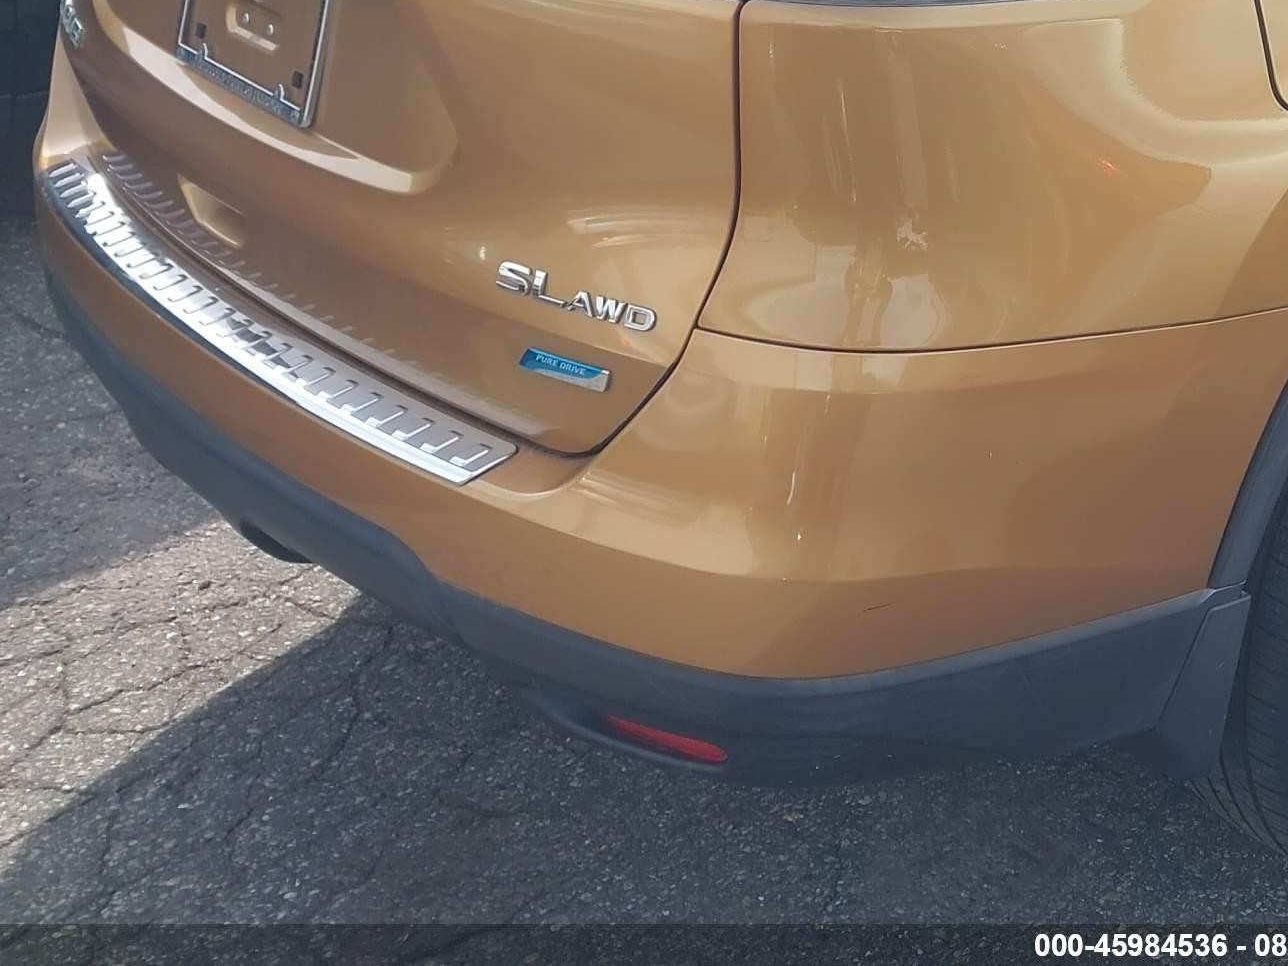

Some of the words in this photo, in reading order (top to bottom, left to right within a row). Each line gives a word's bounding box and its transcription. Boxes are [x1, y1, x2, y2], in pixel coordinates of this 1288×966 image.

[566, 290, 657, 331] AWD
[535, 353, 558, 368] PURE
[559, 361, 587, 376] DRIVE
